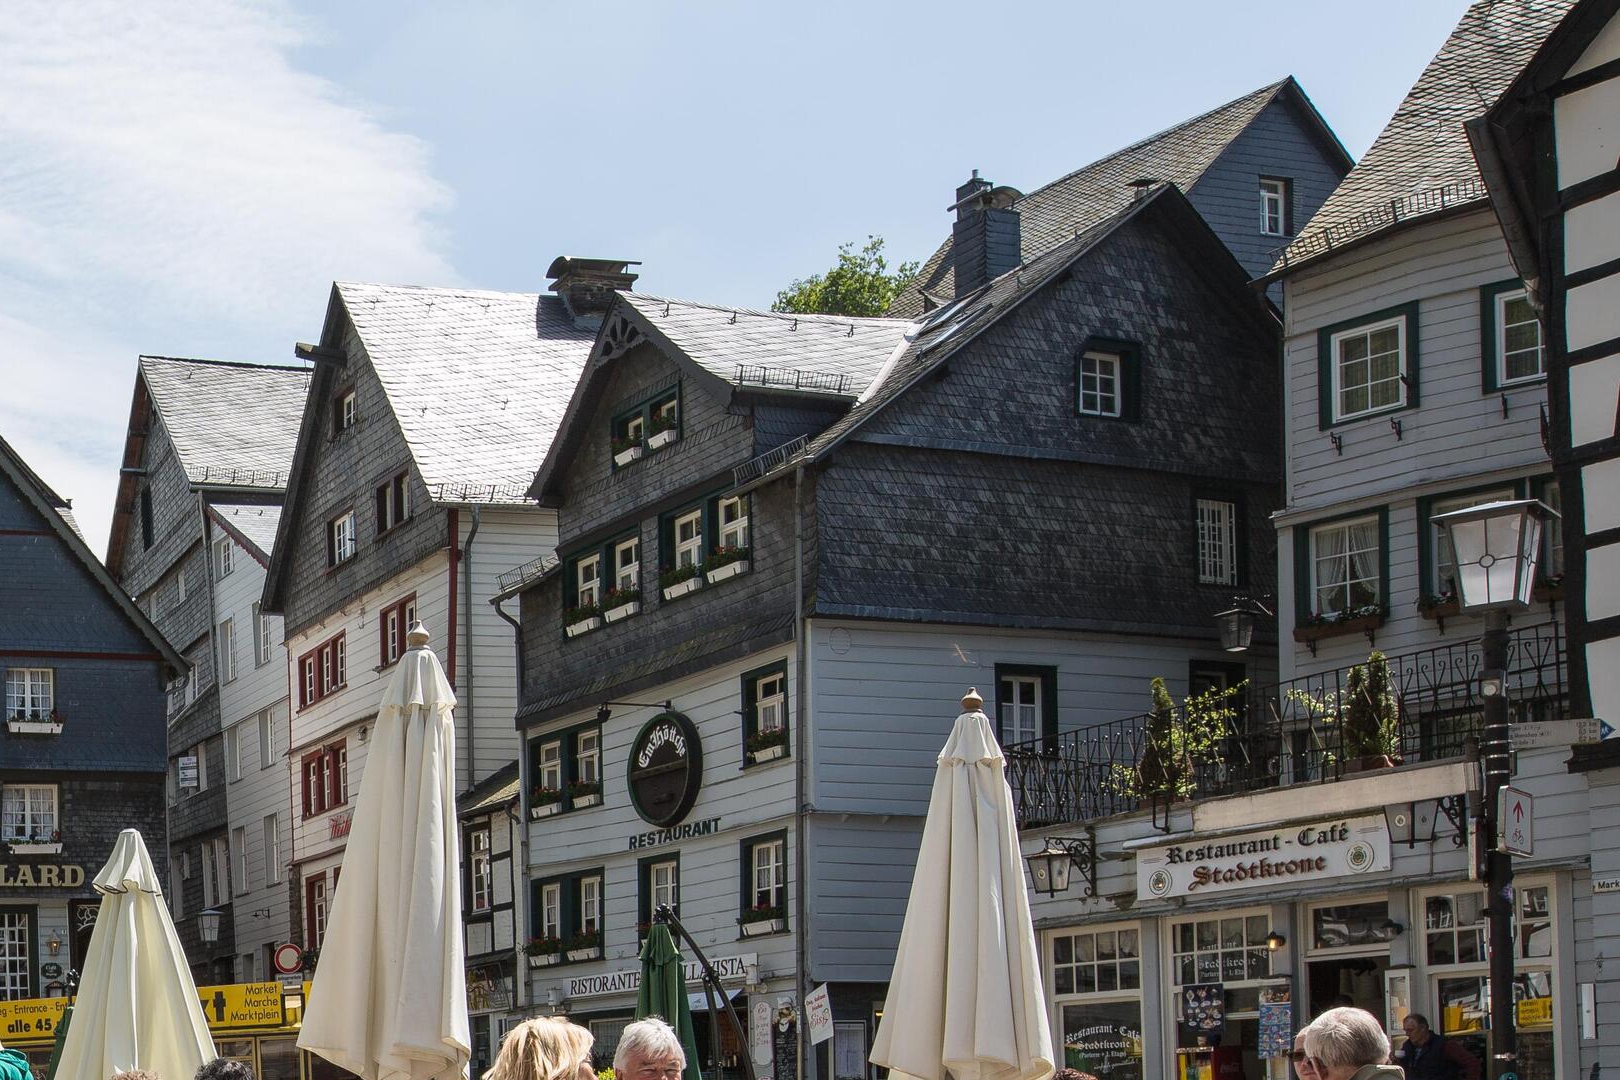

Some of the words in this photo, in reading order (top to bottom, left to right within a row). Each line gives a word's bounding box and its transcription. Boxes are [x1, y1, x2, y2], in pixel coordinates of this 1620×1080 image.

[628, 817, 721, 850] RESTAURANT
[1165, 834, 1280, 865] Restaurant
[1298, 822, 1349, 846] Café
[1188, 855, 1328, 891] Stadtkrone
[1597, 879, 1620, 889] Mark
[245, 983, 278, 995] Market
[570, 971, 640, 995] RISTORANTE
[14, 1003, 47, 1014] Entrance
[55, 1001, 67, 1011] Ent
[230, 1009, 279, 1023] Marktplein
[7, 1019, 30, 1033] alle
[36, 1018, 52, 1031] 45
[1065, 1025, 1113, 1044] Restaurant
